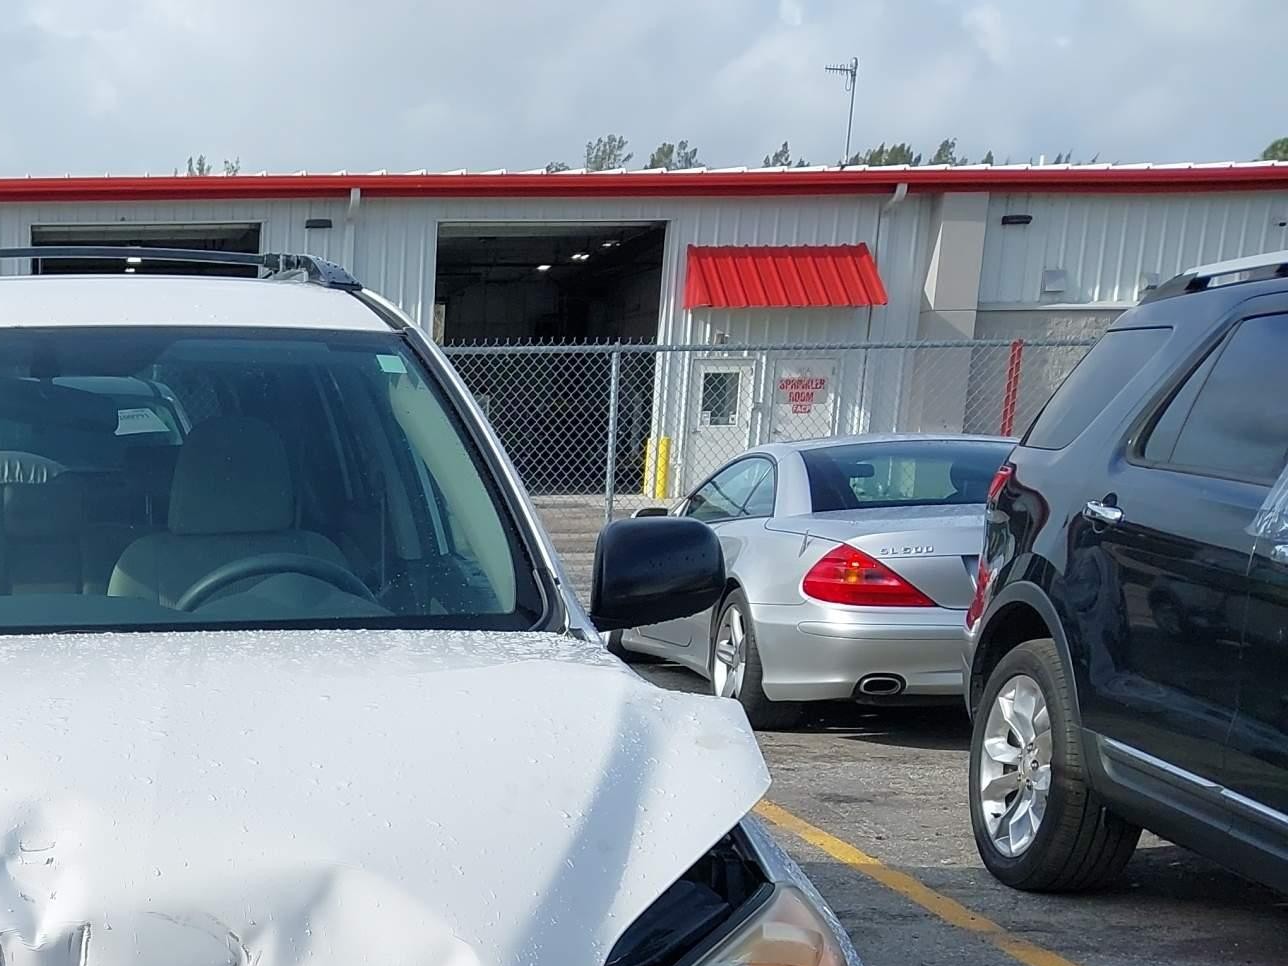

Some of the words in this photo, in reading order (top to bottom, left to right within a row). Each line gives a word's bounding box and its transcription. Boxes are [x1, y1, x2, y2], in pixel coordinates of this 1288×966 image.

[779, 378, 825, 390] SPRINKLER
[789, 391, 814, 402] ROOM
[901, 545, 935, 555] 500
